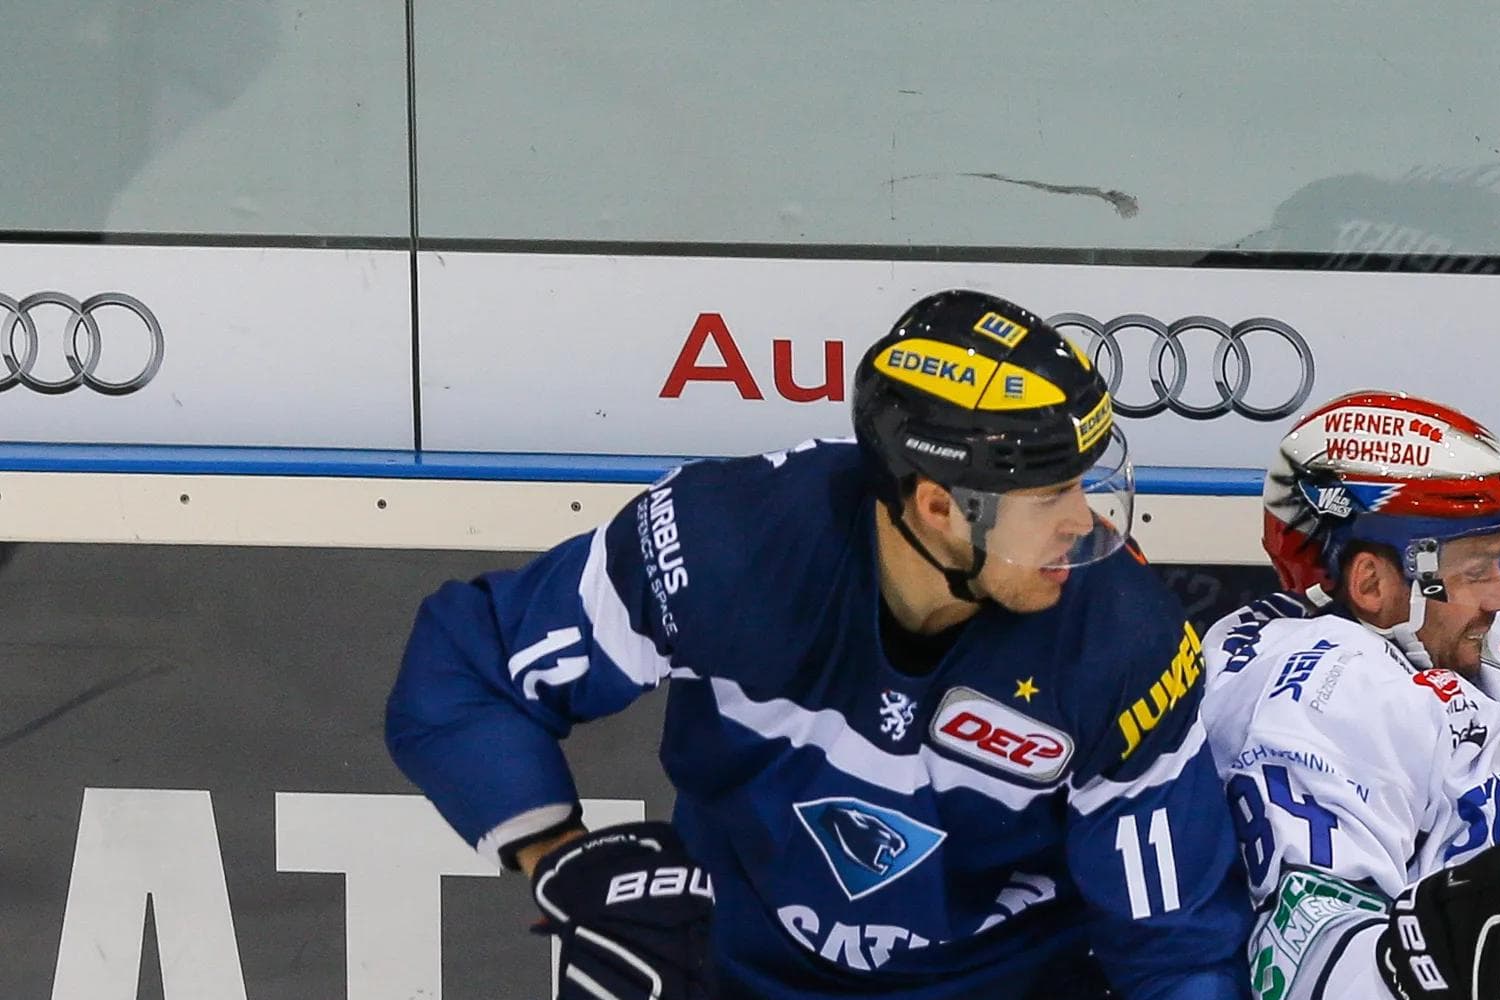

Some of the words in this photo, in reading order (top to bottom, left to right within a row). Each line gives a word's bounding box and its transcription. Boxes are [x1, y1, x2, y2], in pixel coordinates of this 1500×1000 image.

[887, 349, 977, 387] EDEKA
[905, 437, 968, 460] BAUER
[1324, 413, 1405, 437] WERNER
[1326, 438, 1431, 466] WOHNBAU
[650, 487, 690, 595] AIRBUS
[651, 577, 678, 637] SPACE
[939, 711, 1064, 768] DEL
[1226, 763, 1339, 889] 84
[1115, 807, 1181, 921] 11
